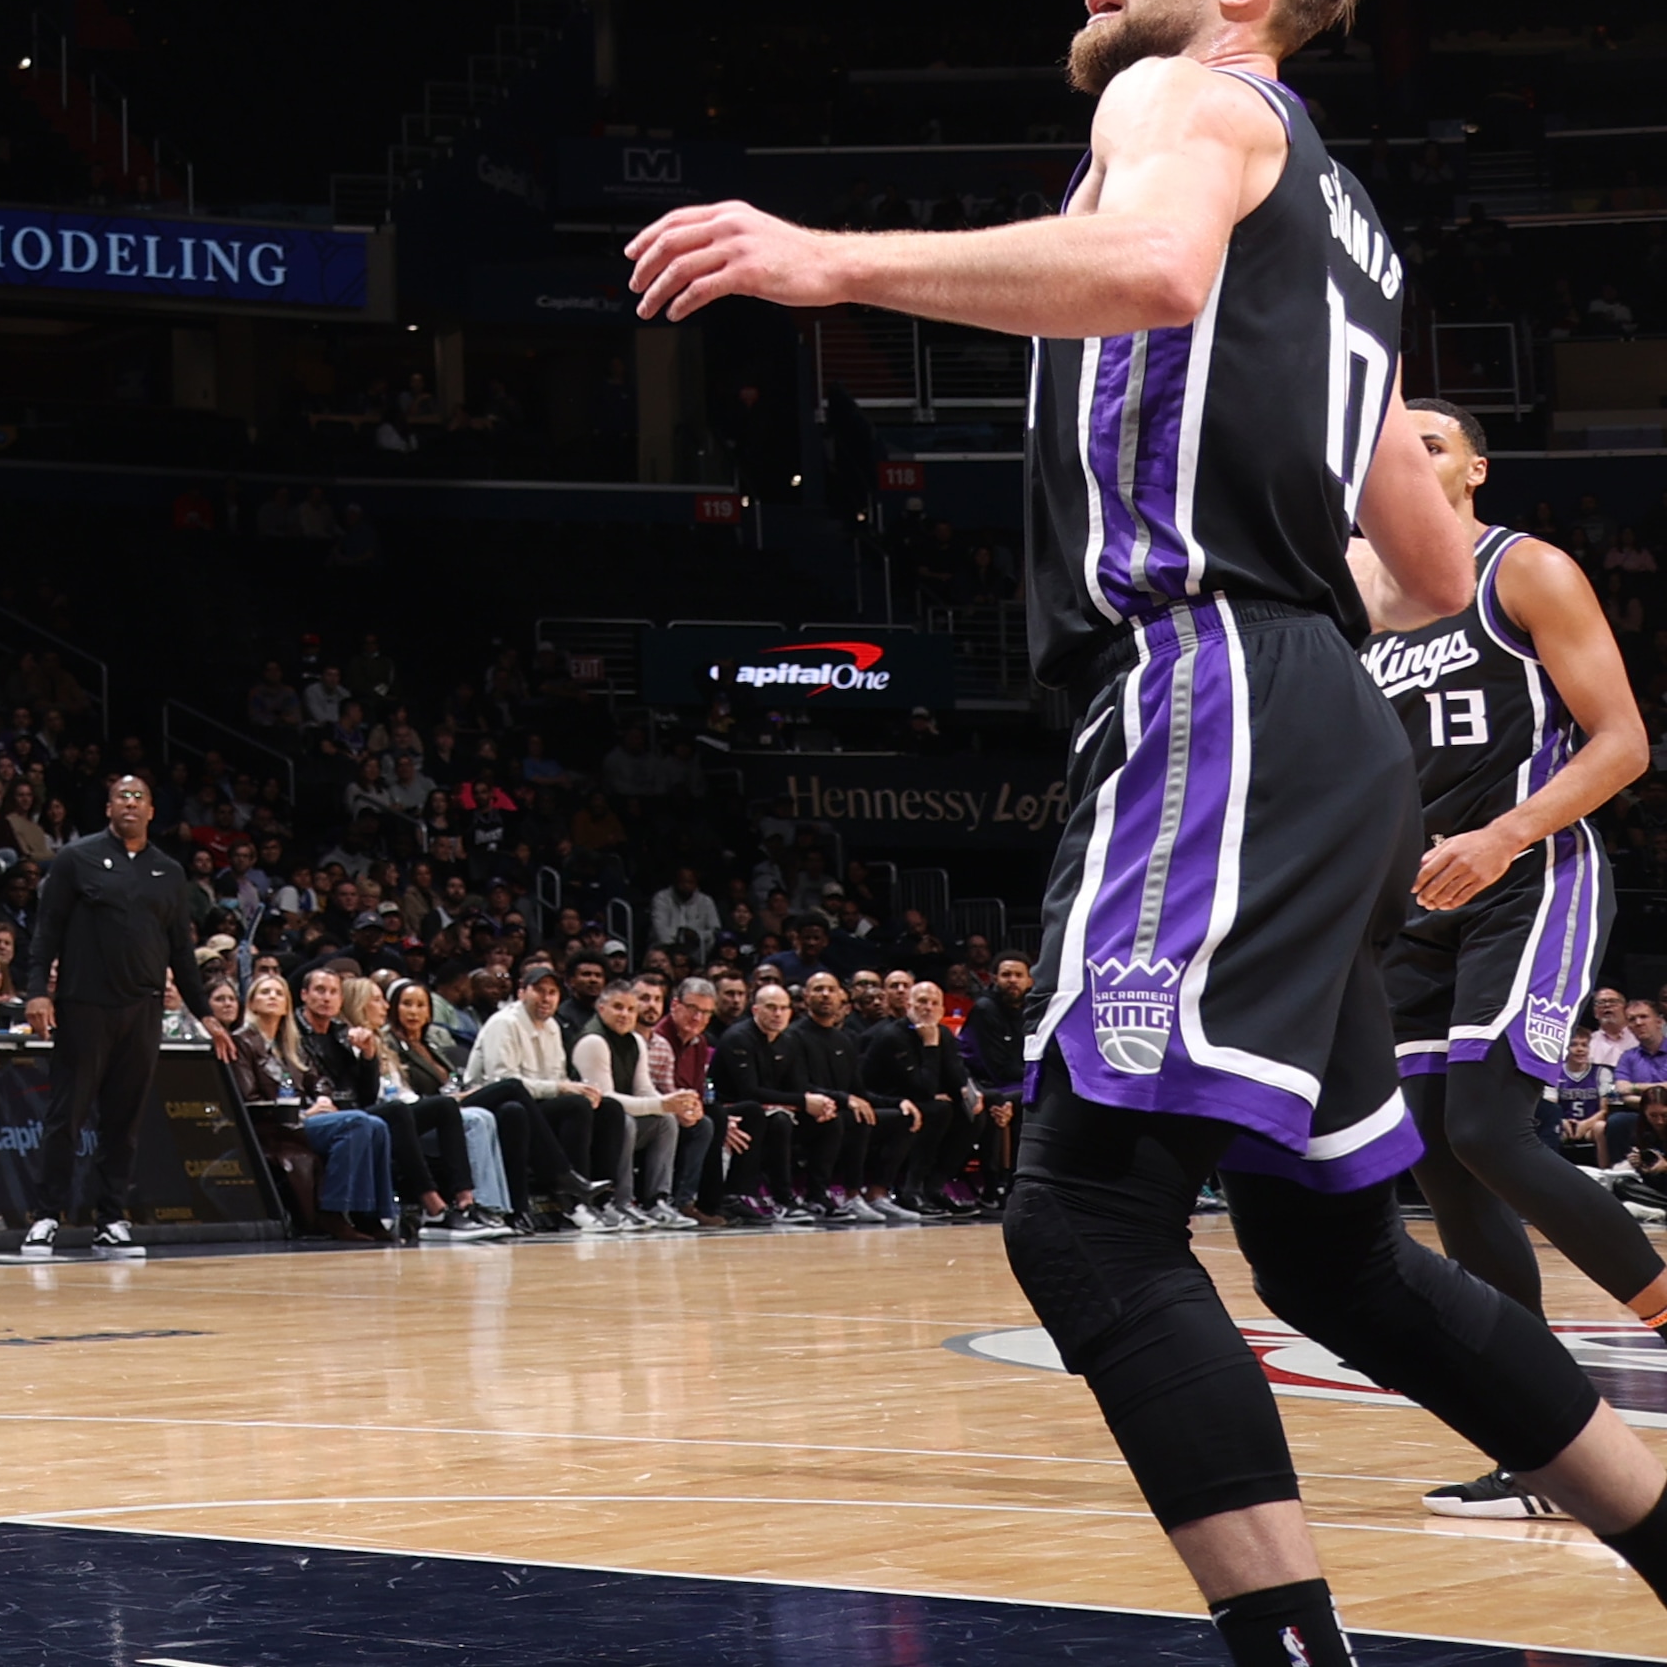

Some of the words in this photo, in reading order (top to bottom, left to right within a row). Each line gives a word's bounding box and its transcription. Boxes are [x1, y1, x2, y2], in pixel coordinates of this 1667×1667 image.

[885, 468, 916, 486] 118
[1361, 627, 1480, 699] Kings
[1426, 690, 1487, 747] 13
[786, 775, 988, 831] Hennessy
[1095, 990, 1175, 1003] SACRAMENT
